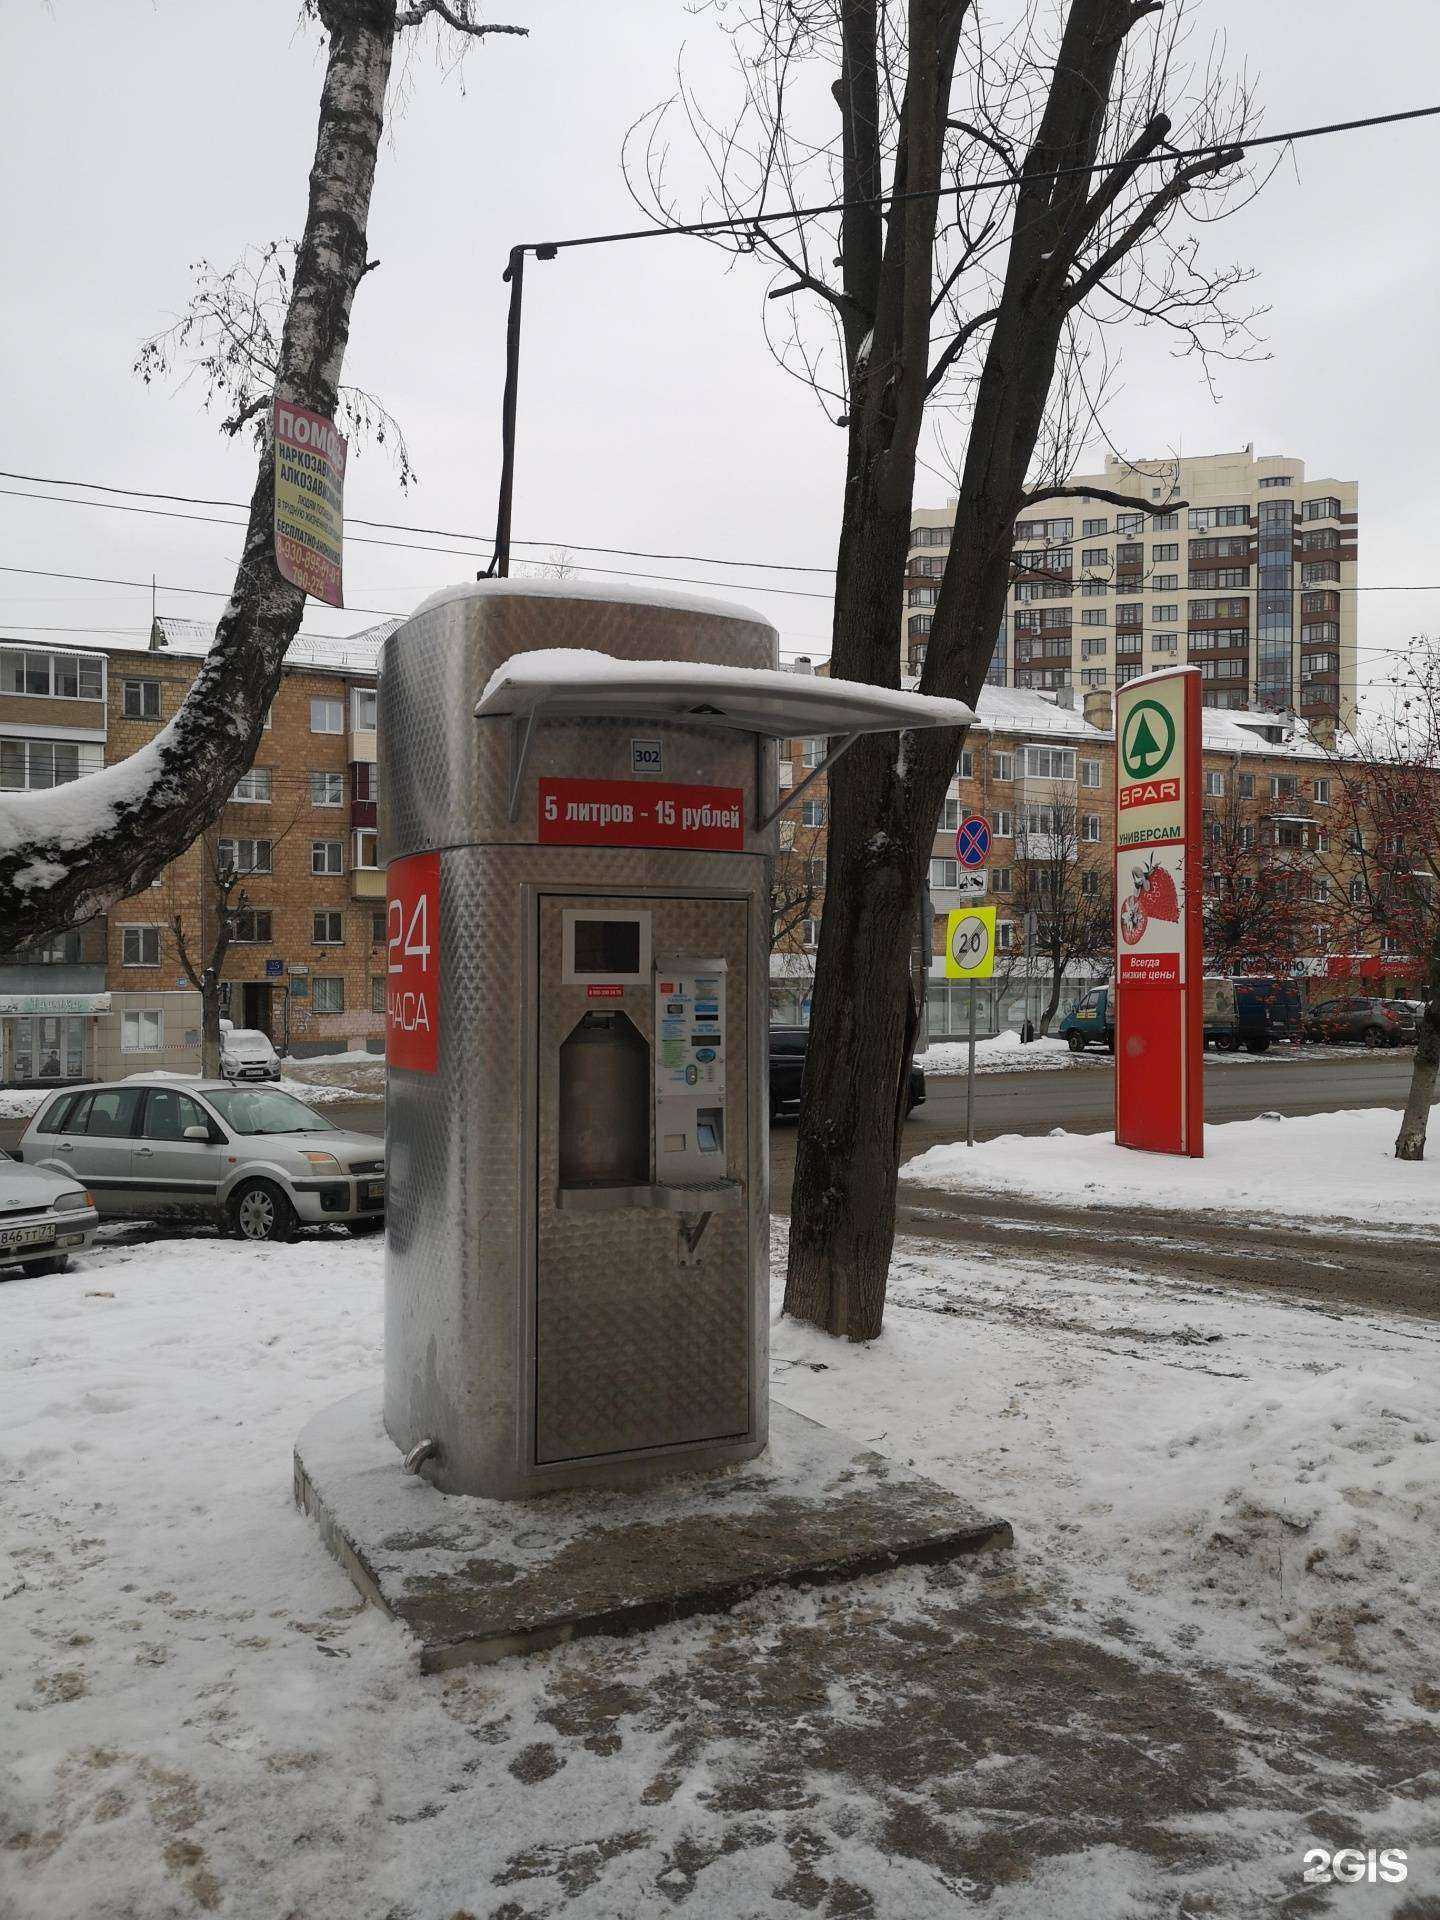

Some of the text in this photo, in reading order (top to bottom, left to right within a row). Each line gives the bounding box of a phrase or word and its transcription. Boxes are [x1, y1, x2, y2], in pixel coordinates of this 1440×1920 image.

[635, 750, 660, 763] 302
[1121, 782, 1176, 806] SPAR
[545, 795, 558, 821] 5
[566, 801, 634, 827] литров
[656, 800, 676, 825] 15
[682, 805, 740, 831] рублей
[1119, 826, 1181, 845] УНИВЕРСАМ
[388, 894, 431, 973] 24
[959, 932, 981, 953] 20
[1130, 957, 1160, 968] Всегда
[1149, 970, 1176, 980] цены
